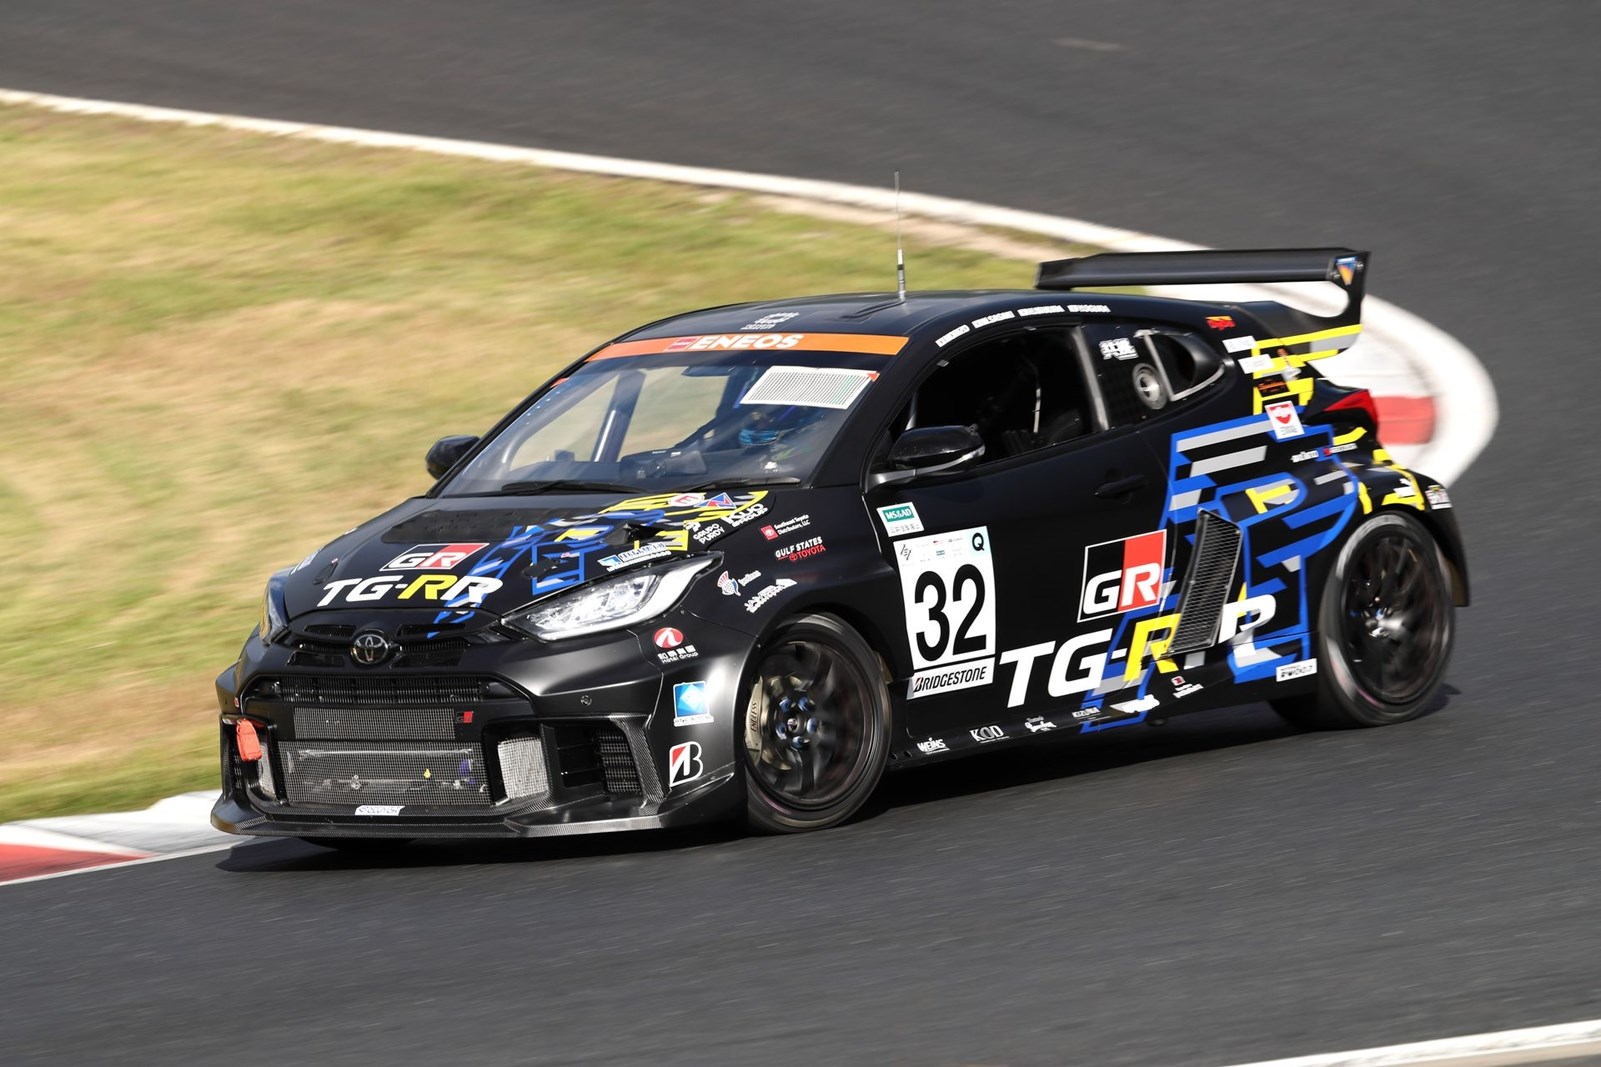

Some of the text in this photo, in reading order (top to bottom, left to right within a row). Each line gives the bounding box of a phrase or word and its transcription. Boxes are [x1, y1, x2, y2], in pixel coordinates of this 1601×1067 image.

[687, 334, 805, 350] ENEOS
[721, 503, 764, 524] KUO
[885, 508, 912, 520] MS&AD
[693, 523, 720, 540] GRUPO
[699, 527, 725, 545] PURDY
[775, 536, 823, 558] GULF STATES
[971, 532, 985, 551] Q
[389, 552, 467, 568] GR
[797, 544, 827, 559] TOYOTA
[317, 574, 504, 607] TG-RR
[1083, 562, 1161, 614] GR
[914, 563, 987, 662] 32
[913, 666, 987, 693] BRIDGESTONE
[969, 725, 1004, 742] KOD
